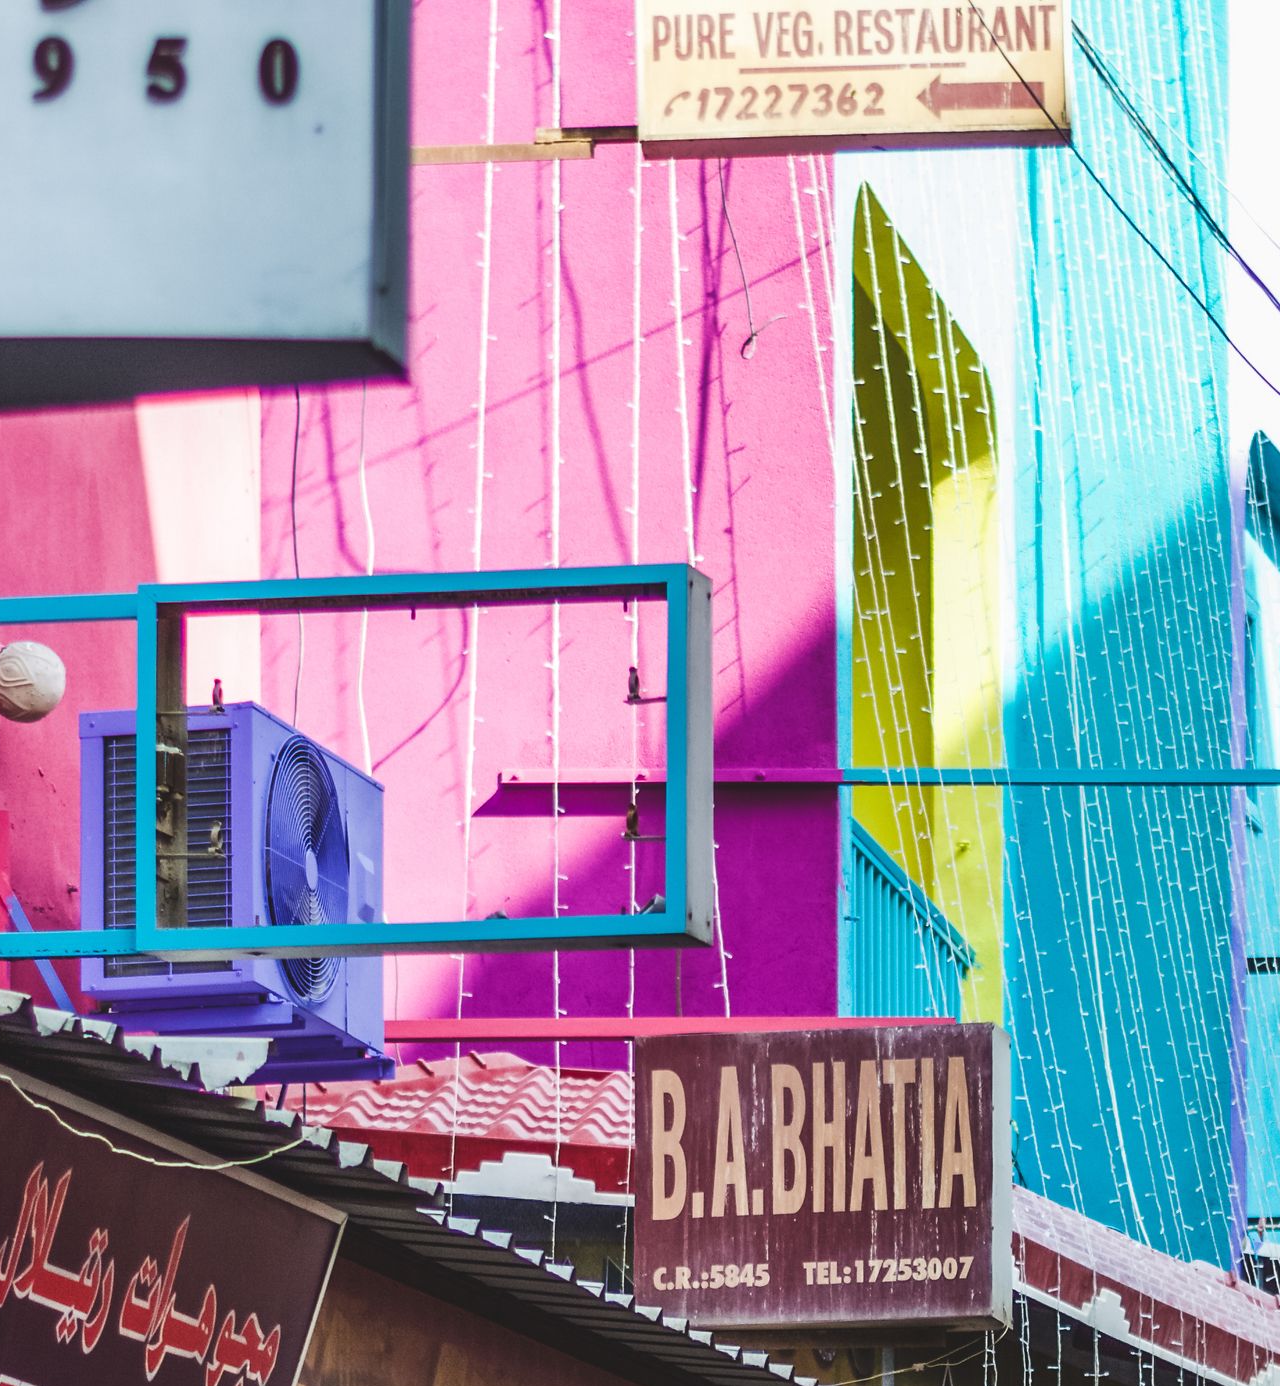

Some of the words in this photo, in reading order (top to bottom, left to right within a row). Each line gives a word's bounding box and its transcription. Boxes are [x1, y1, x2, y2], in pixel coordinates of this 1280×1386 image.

[652, 12, 737, 62] PURE
[752, 9, 824, 59] VEG.
[834, 4, 1058, 56] RESTAURANT
[696, 81, 887, 122] 17227362
[651, 1056, 978, 1221] B.A.BHATIA
